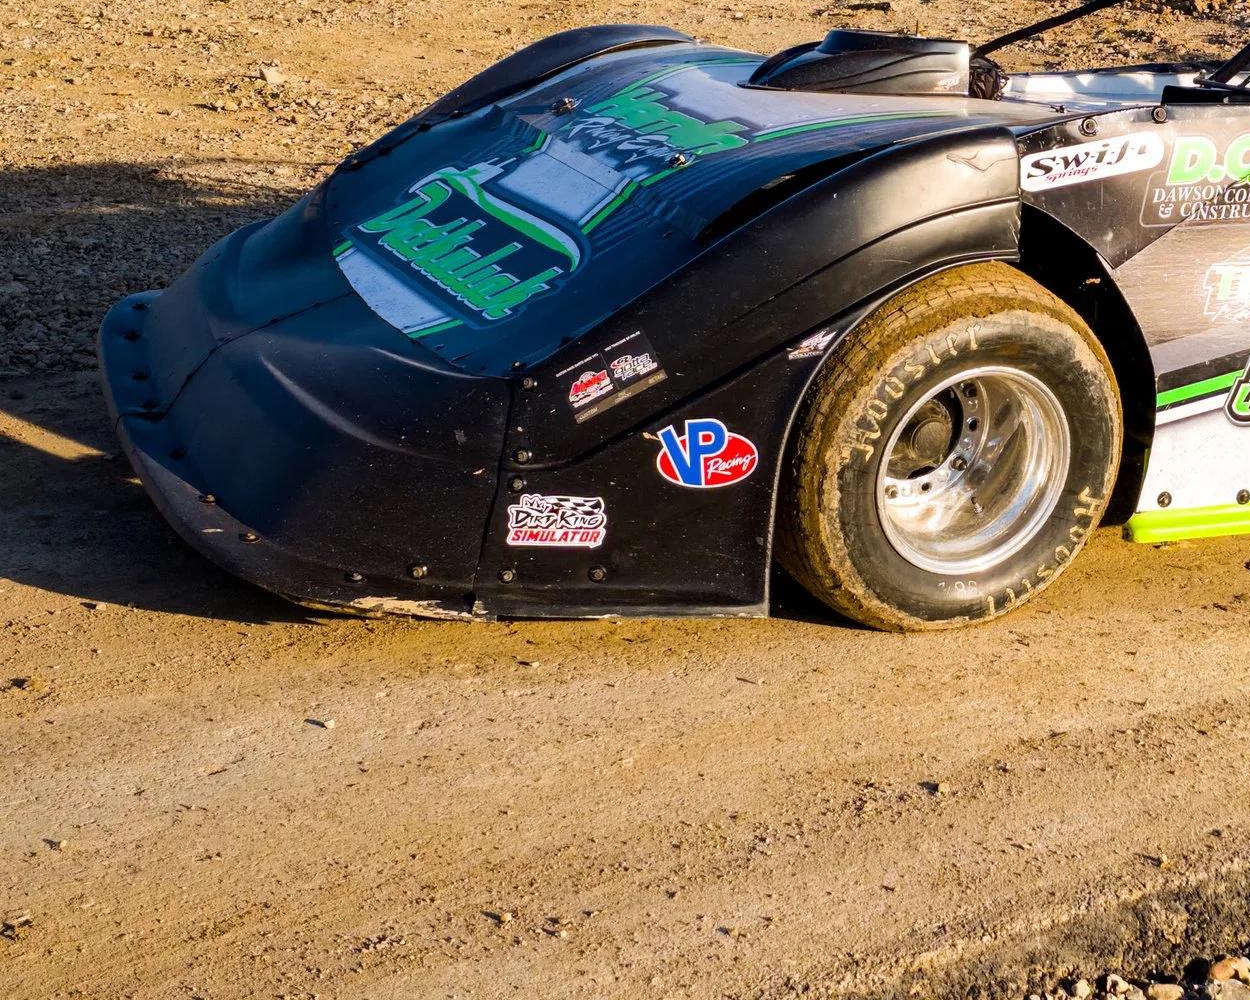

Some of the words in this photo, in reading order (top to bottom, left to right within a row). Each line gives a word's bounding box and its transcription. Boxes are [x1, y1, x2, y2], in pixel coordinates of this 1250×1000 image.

[1046, 165, 1098, 182] springs
[1153, 185, 1226, 205] DAWSON
[1158, 203, 1174, 218] &
[657, 419, 728, 488] VP
[707, 454, 757, 479] Racing
[511, 529, 600, 543] SIMULATOR
